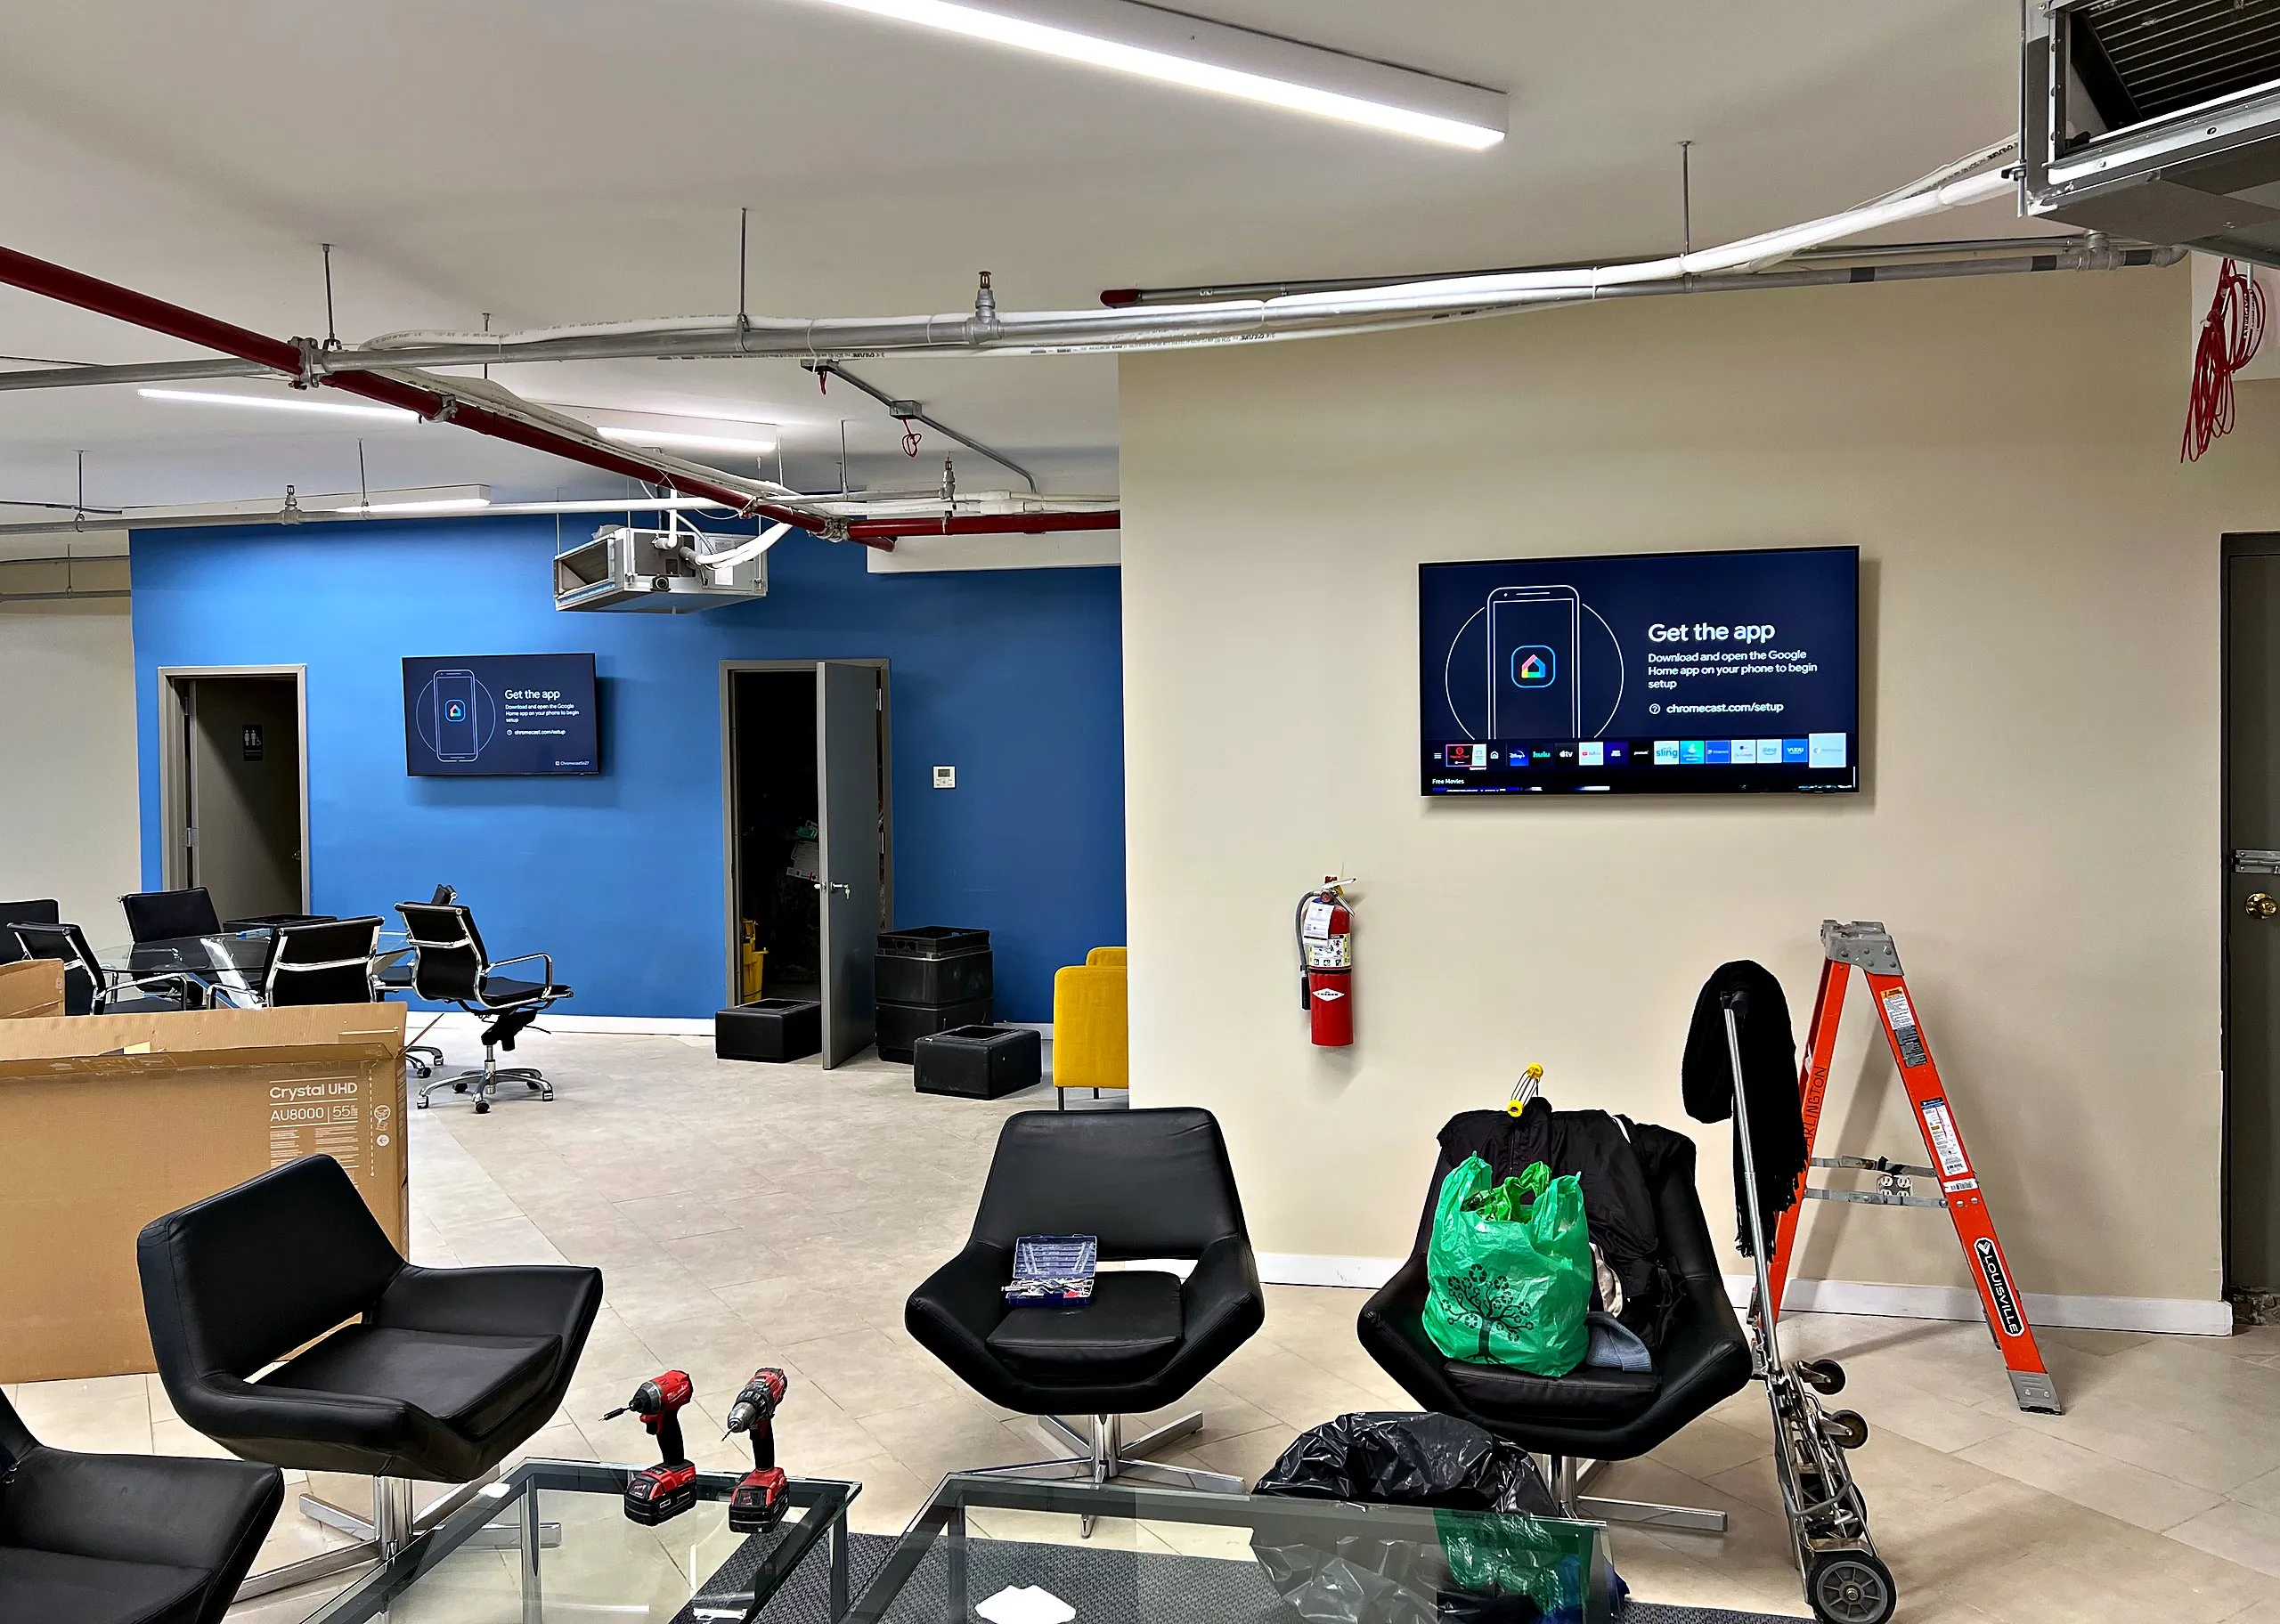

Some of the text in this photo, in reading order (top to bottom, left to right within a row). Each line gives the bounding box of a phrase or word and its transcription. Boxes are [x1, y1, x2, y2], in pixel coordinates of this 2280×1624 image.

[1648, 622, 1775, 644] Get the app
[1648, 650, 1807, 662] Download and open the Google
[1648, 662, 1818, 677] Home app on your phone to begin
[1648, 679, 1677, 690] setup
[504, 689, 561, 701] Get the app
[1666, 702, 1784, 714] chromecast.com/setup
[1533, 751, 1551, 759] hulu
[1656, 747, 1678, 759] sling
[269, 1082, 358, 1101] Crystal UHD
[270, 1108, 324, 1122] AU8000
[1984, 1255, 2019, 1335] LOUISVILLE
